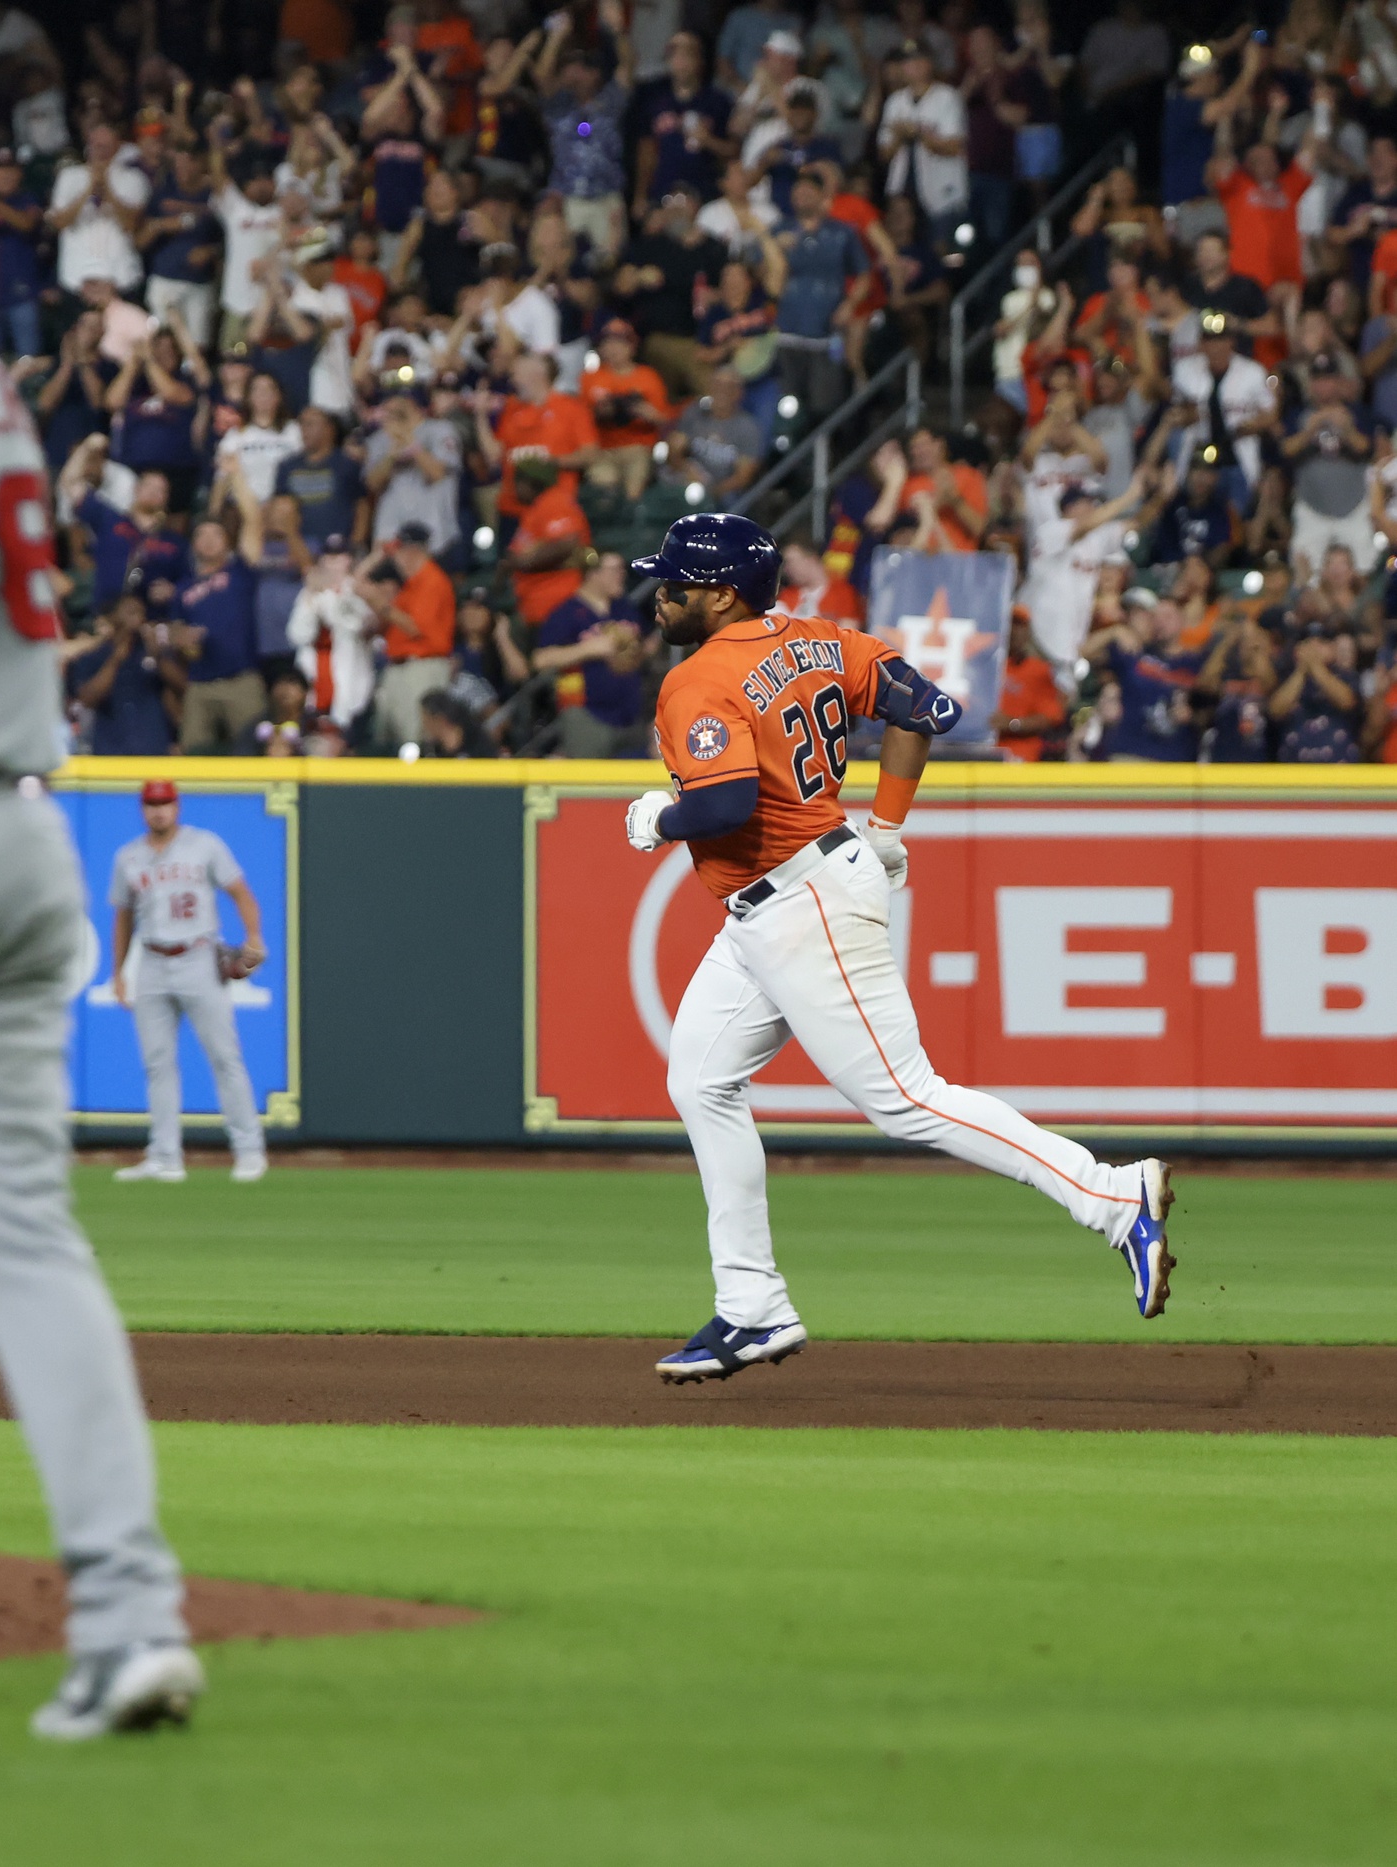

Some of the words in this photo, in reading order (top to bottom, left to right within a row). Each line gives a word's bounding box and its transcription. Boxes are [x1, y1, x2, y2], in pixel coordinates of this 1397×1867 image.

[741, 638, 844, 715] SINGLETON
[689, 718, 723, 735] HOUSTON
[780, 681, 849, 804] 28
[693, 744, 723, 759] ASTROS
